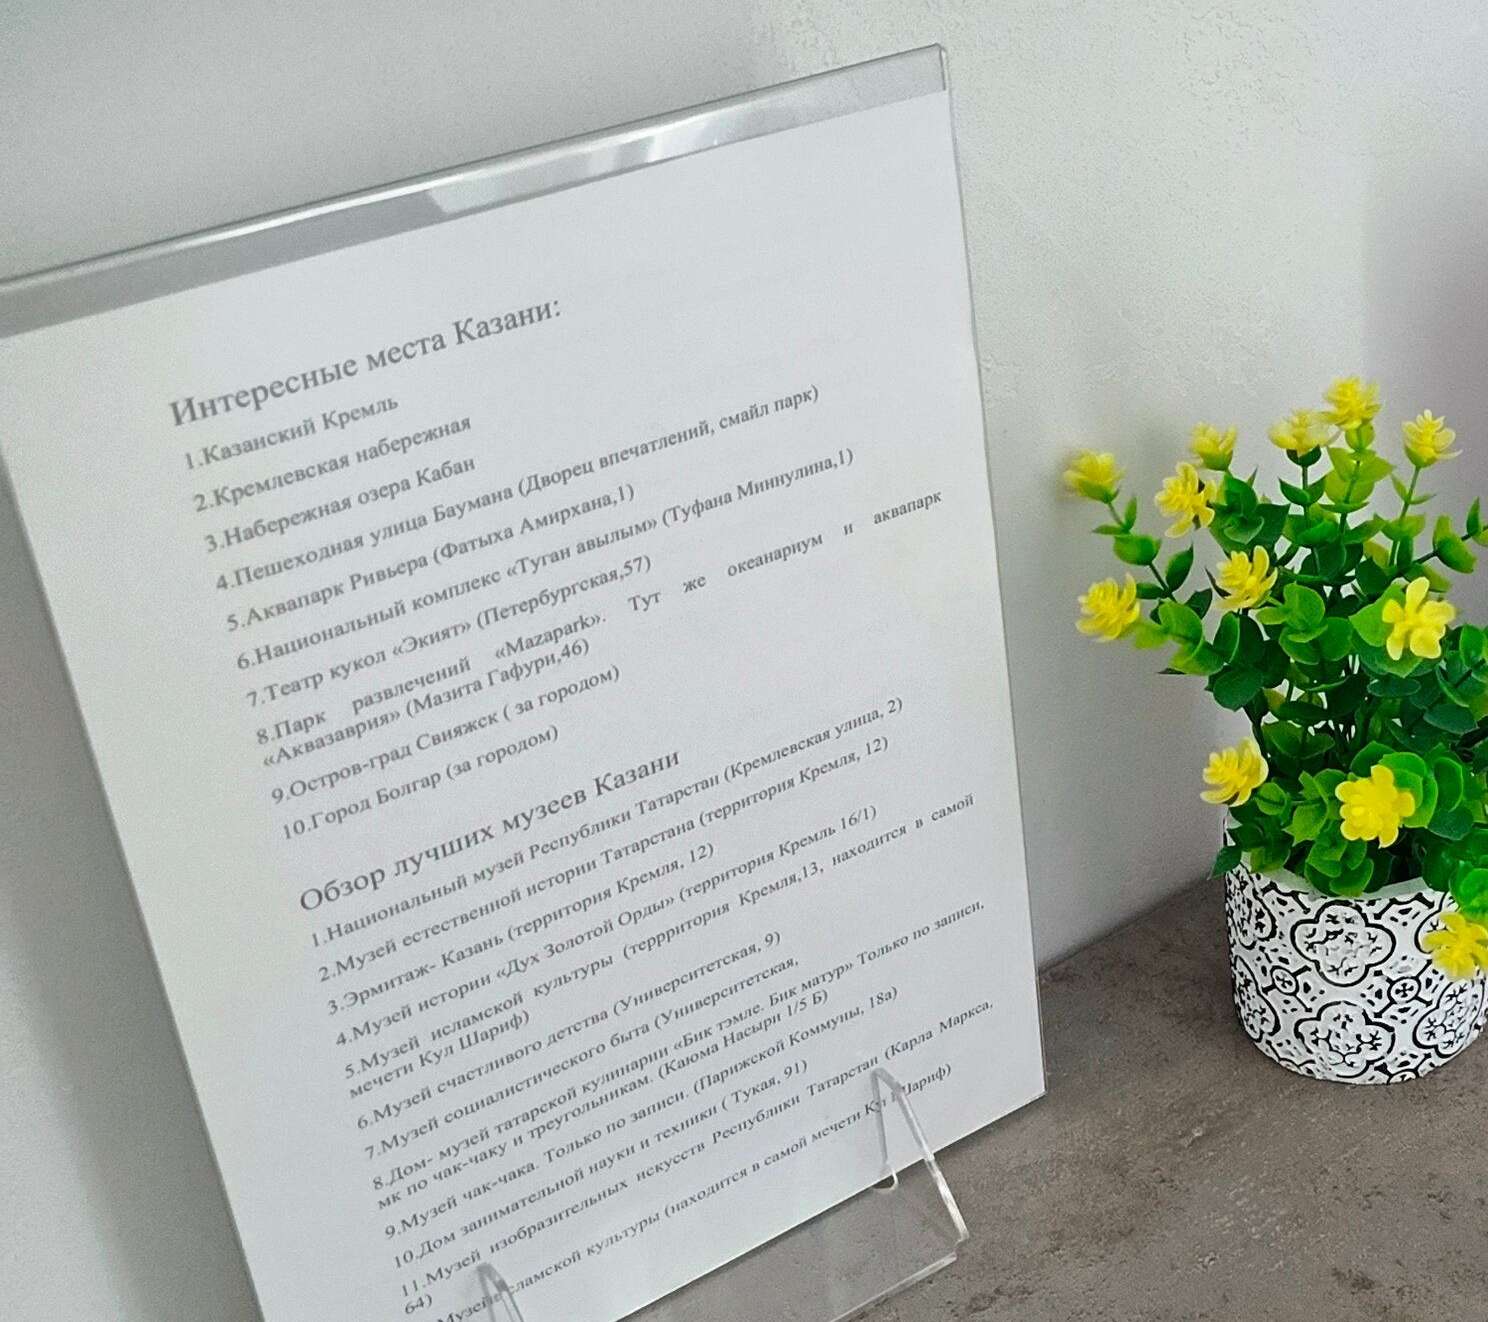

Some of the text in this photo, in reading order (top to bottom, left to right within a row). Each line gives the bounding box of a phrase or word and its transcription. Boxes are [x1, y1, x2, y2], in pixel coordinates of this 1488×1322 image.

[168, 299, 560, 426] Интересные места Казани:
[184, 397, 398, 470] 1.Казанский Кремль
[192, 417, 471, 512] 2.Кремлевская набережная
[203, 458, 475, 553] 3.Набережная озера Кабан
[215, 384, 818, 590] 4.Пешеходная улица Баумана (Дворец впечатлений, смайл парк)
[226, 483, 634, 632] 5.Аквапарк Ривьера (Фатыха Амирхана,1)
[236, 447, 853, 669] 6.Национальный комплекс «Туган авылым» (Туфана Миннулина,1)
[245, 554, 651, 707] 7.Театр кукол «Экият» (Петербургская,57)
[255, 491, 941, 745] 8.Парк развлечений «Mazapark». Тут же океанариум и аквапарк
[405, 679, 483, 718] (Мазита
[486, 638, 589, 686] Гафури,46)
[283, 724, 558, 839] 10.Город Болгар (за городом)
[299, 750, 679, 910] Обзор лучших музеев Казани
[311, 697, 902, 947] 1.Национальный музей Республики Татарстан (Кремлевская улица, 2)
[335, 805, 876, 1045] 4.Музей истории «Дух Золотой Орды» (территория Кремль 16/1)
[356, 931, 780, 1130] 6.Музей счастливого детства (Университетская, 9)
[384, 986, 897, 1240] 9.Музей чак-чака. Только по записи. (Парижской Коммуны, 18а)
